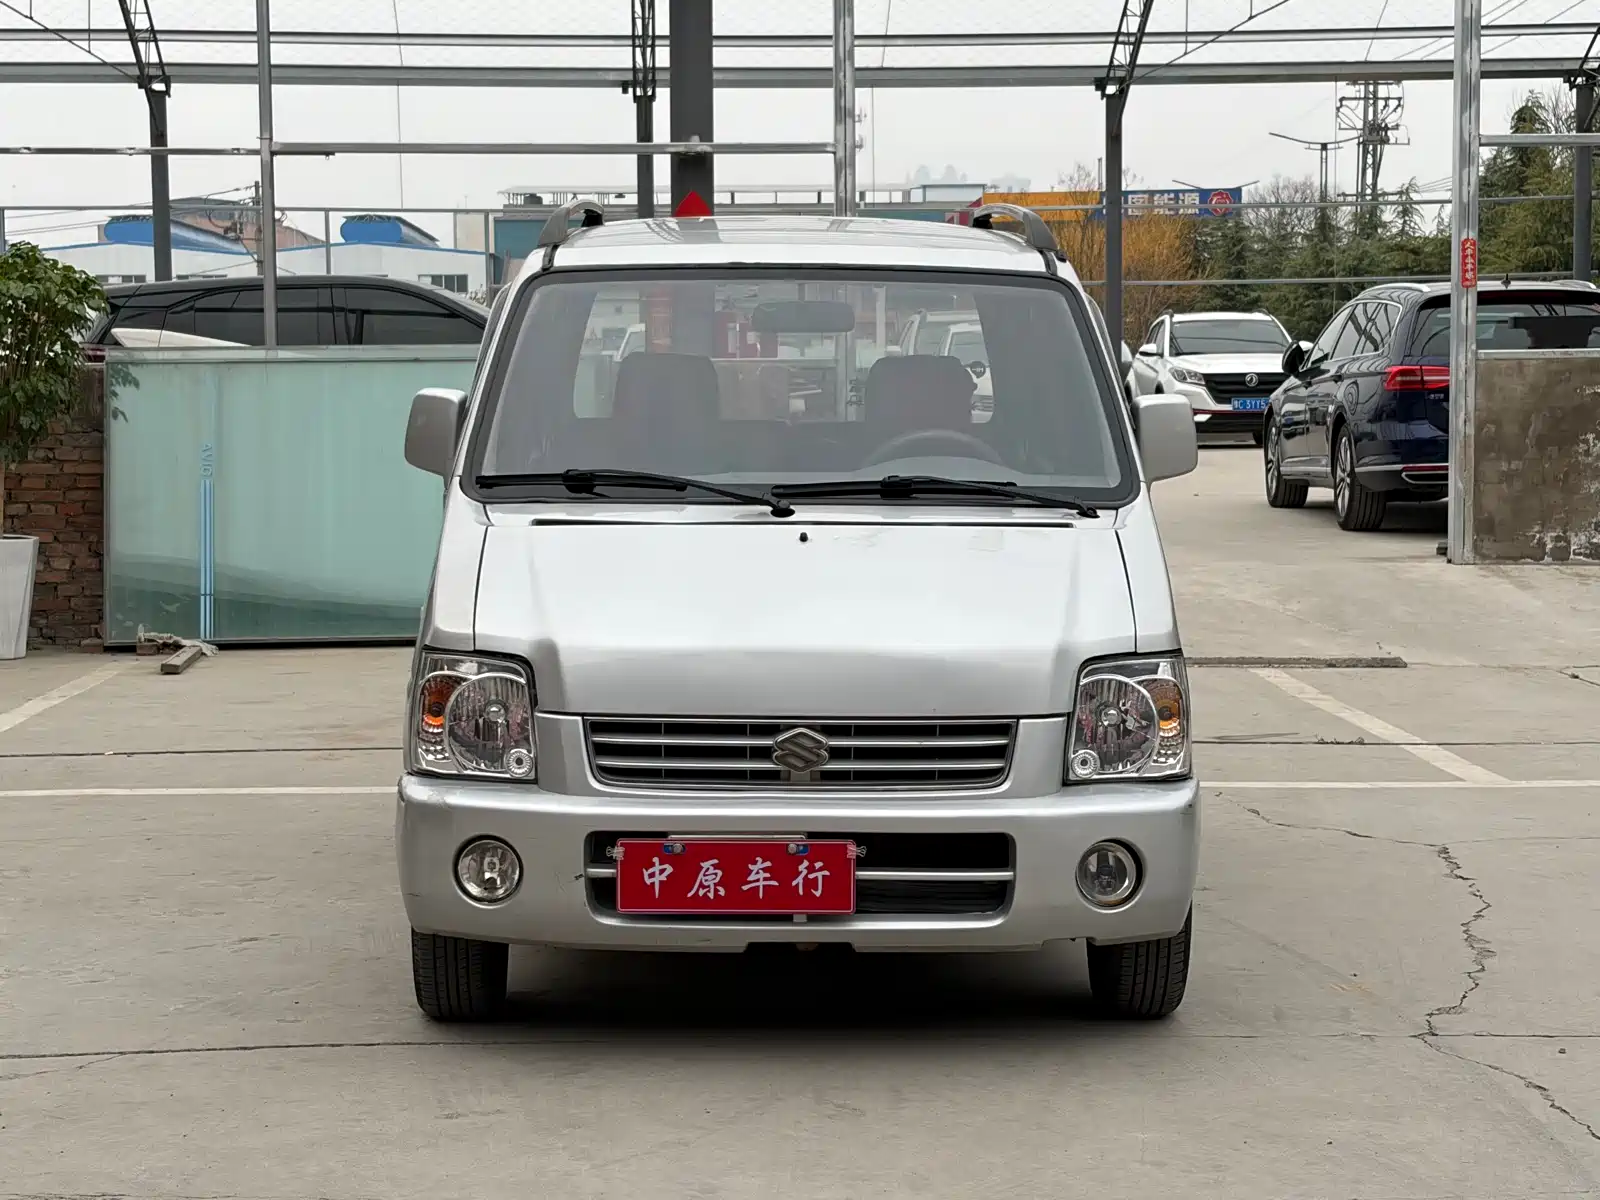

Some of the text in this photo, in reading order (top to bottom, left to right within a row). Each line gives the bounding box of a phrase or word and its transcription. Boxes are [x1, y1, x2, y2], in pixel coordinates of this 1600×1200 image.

[1103, 192, 1200, 216] 国能源
[642, 856, 831, 900] 中原车行
